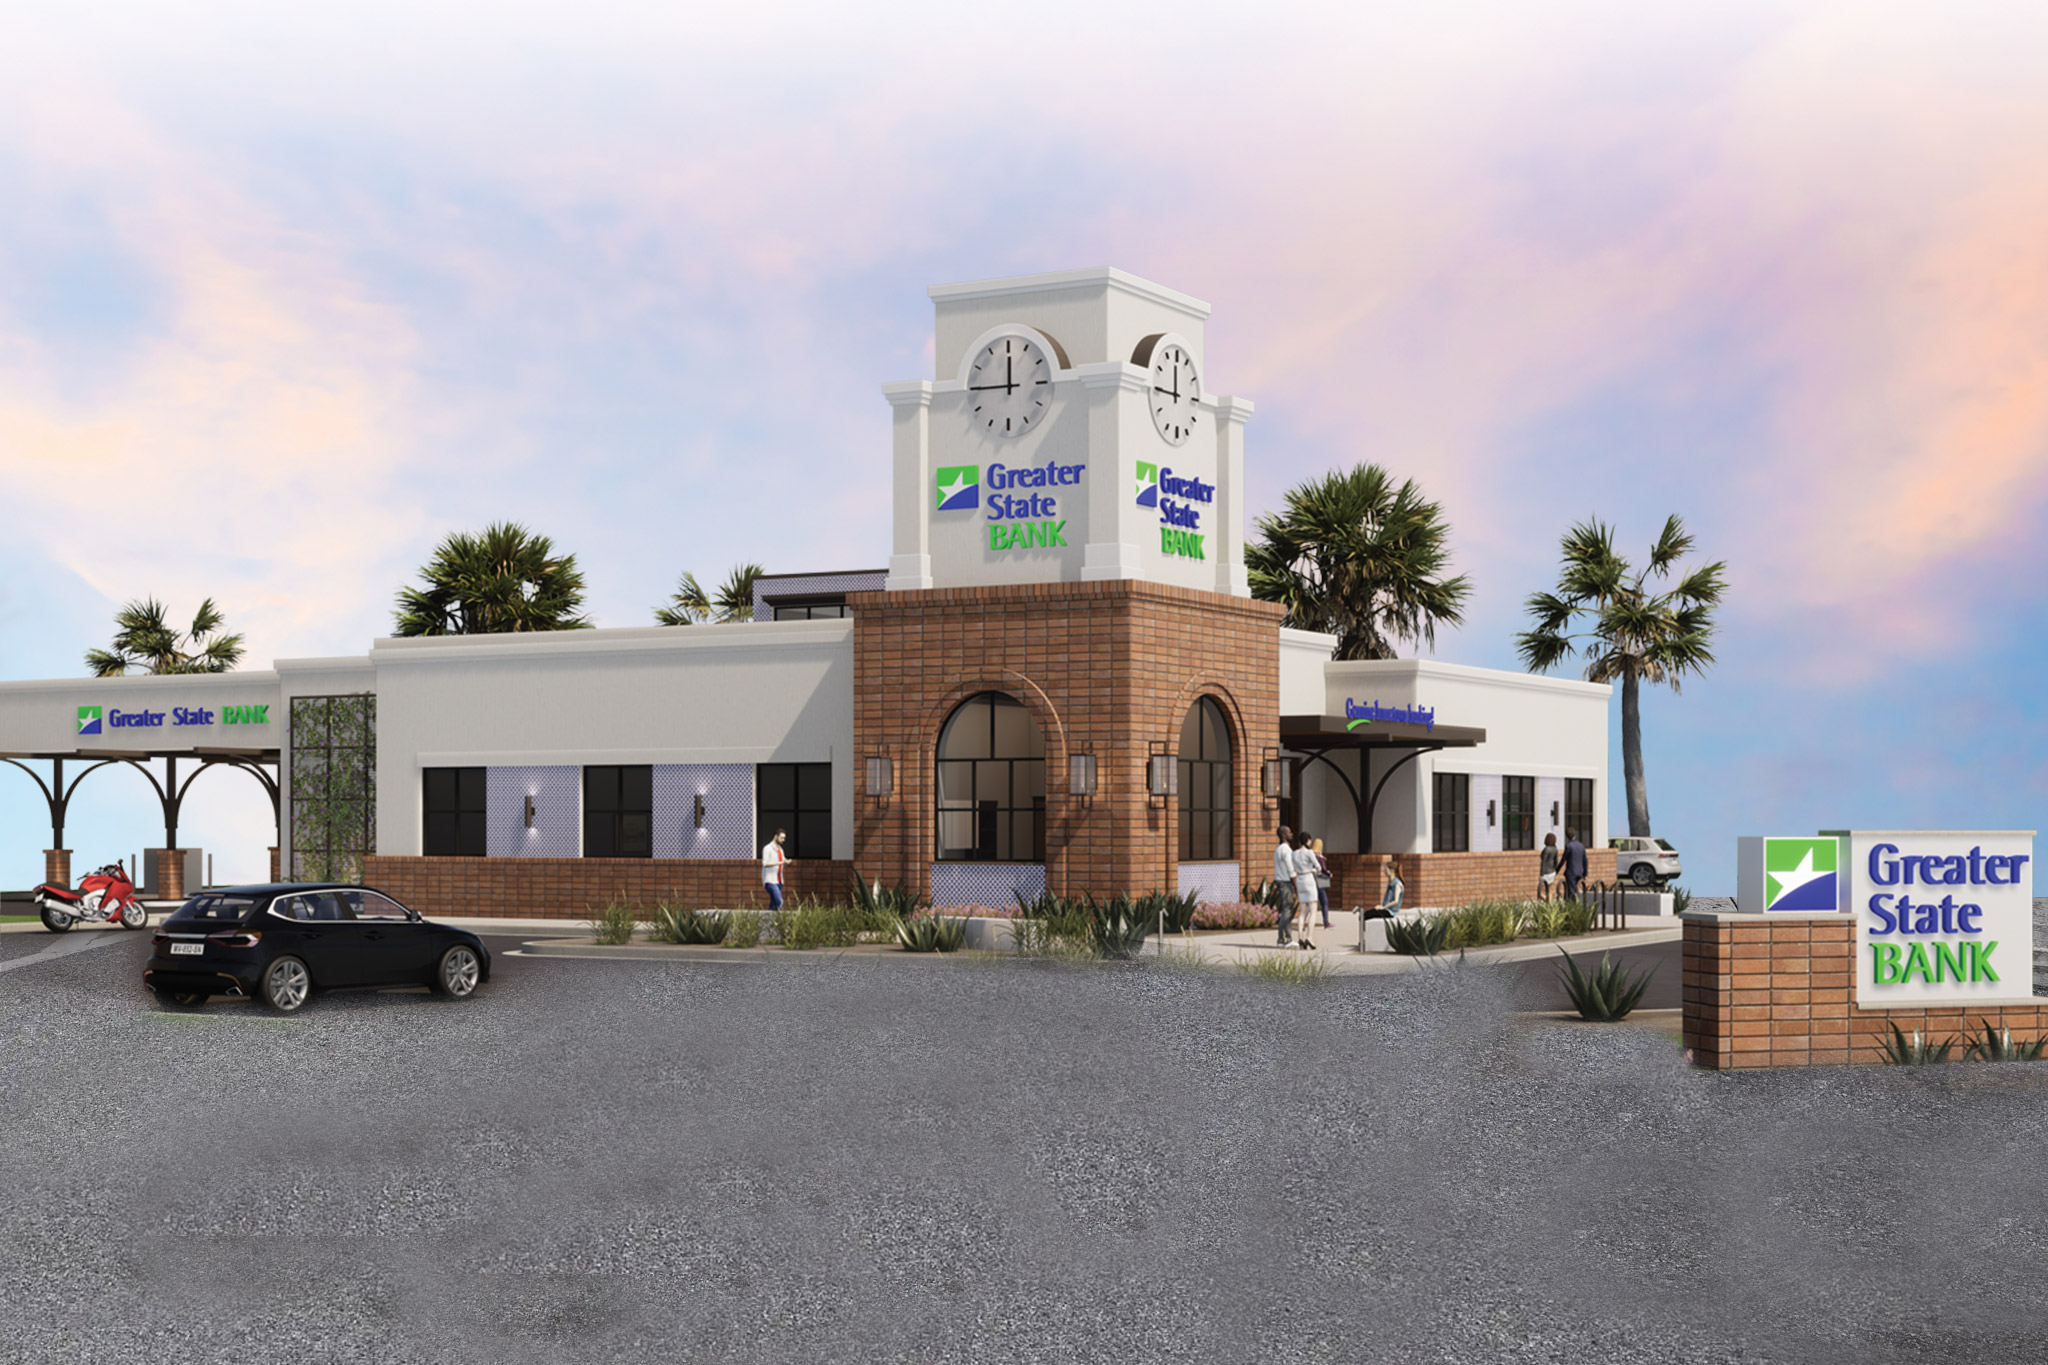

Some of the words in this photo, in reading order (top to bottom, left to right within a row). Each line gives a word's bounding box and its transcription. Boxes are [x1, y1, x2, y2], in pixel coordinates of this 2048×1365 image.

[987, 461, 1086, 490] Greater
[1159, 467, 1215, 504] Greater
[987, 492, 1057, 520] State
[1159, 497, 1201, 529] State
[988, 520, 1068, 551] BANK
[1160, 526, 1206, 560] BANK
[109, 708, 166, 728] Greater
[172, 706, 214, 726] State
[221, 704, 270, 725] BANK
[1868, 843, 2030, 886] Greater
[1868, 893, 1983, 935] State
[1869, 940, 2001, 985] BANK
